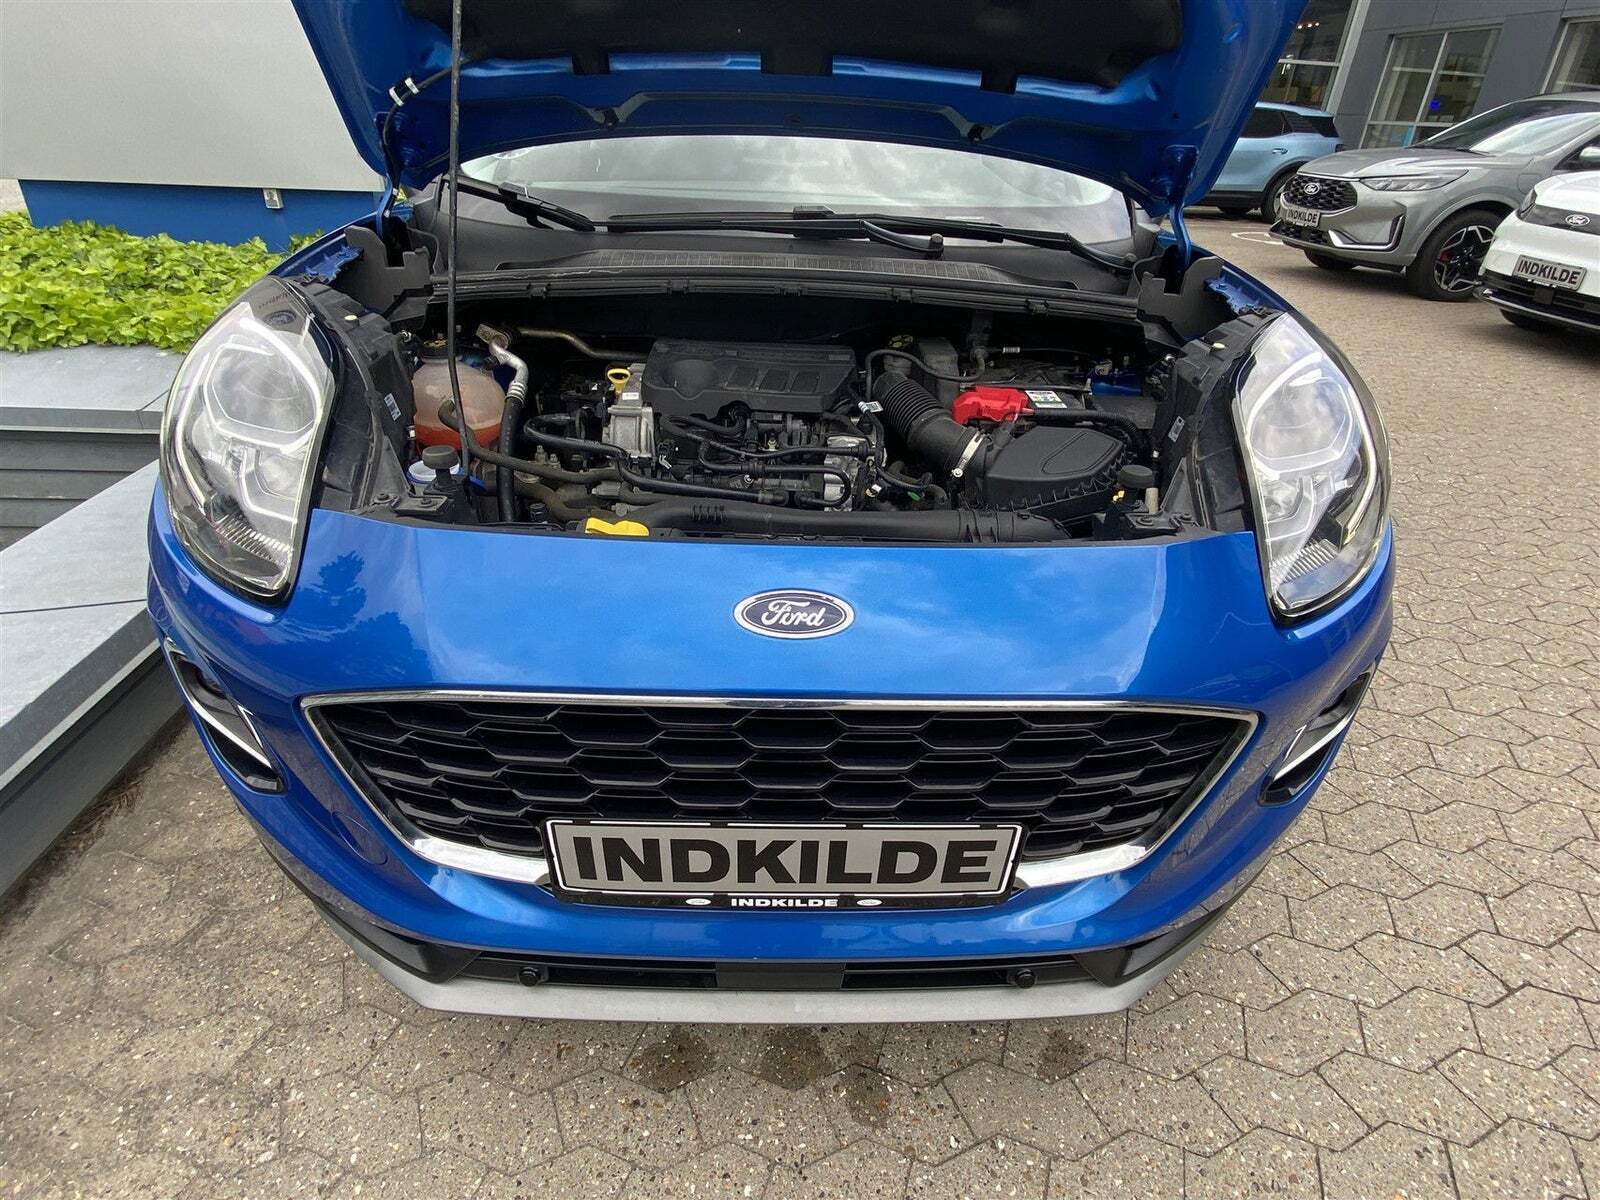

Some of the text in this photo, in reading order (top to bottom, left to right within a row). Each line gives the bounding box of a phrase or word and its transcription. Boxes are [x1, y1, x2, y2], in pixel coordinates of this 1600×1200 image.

[1518, 260, 1580, 284] INDKILDE
[761, 600, 826, 626] Ford
[573, 836, 998, 884] INDKILDE
[731, 898, 838, 907] INDKILDE
